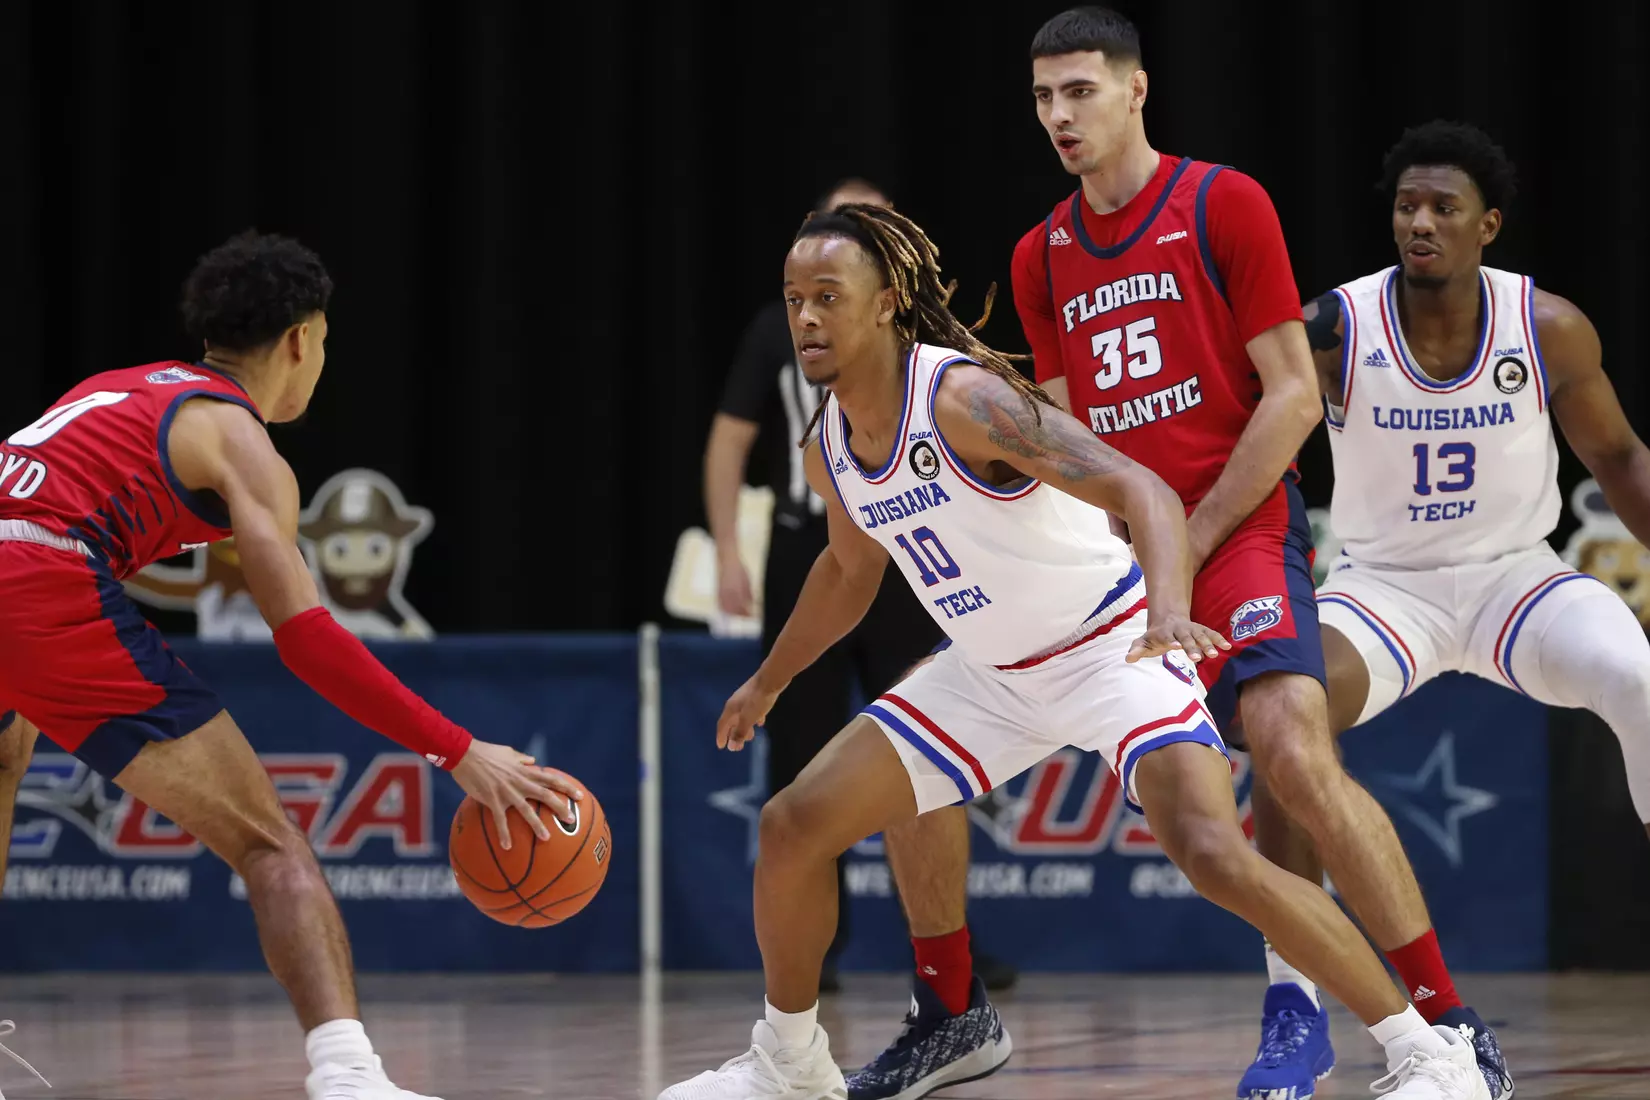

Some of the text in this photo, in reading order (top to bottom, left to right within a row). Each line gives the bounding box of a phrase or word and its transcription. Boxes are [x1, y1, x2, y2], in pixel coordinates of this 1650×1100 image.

[1063, 273, 1182, 332] FLORIDA
[1091, 317, 1162, 390] 35
[1363, 359, 1391, 368] adidas
[7, 391, 130, 445] 0
[1088, 376, 1202, 434] ATLANTIC
[1373, 402, 1515, 431] LOUISIANA
[0, 453, 47, 498] YD
[1413, 442, 1476, 496] 13
[859, 482, 951, 528] OUISIANA
[1408, 500, 1476, 521] TECH
[895, 526, 961, 587] 10
[934, 586, 992, 619] TECH
